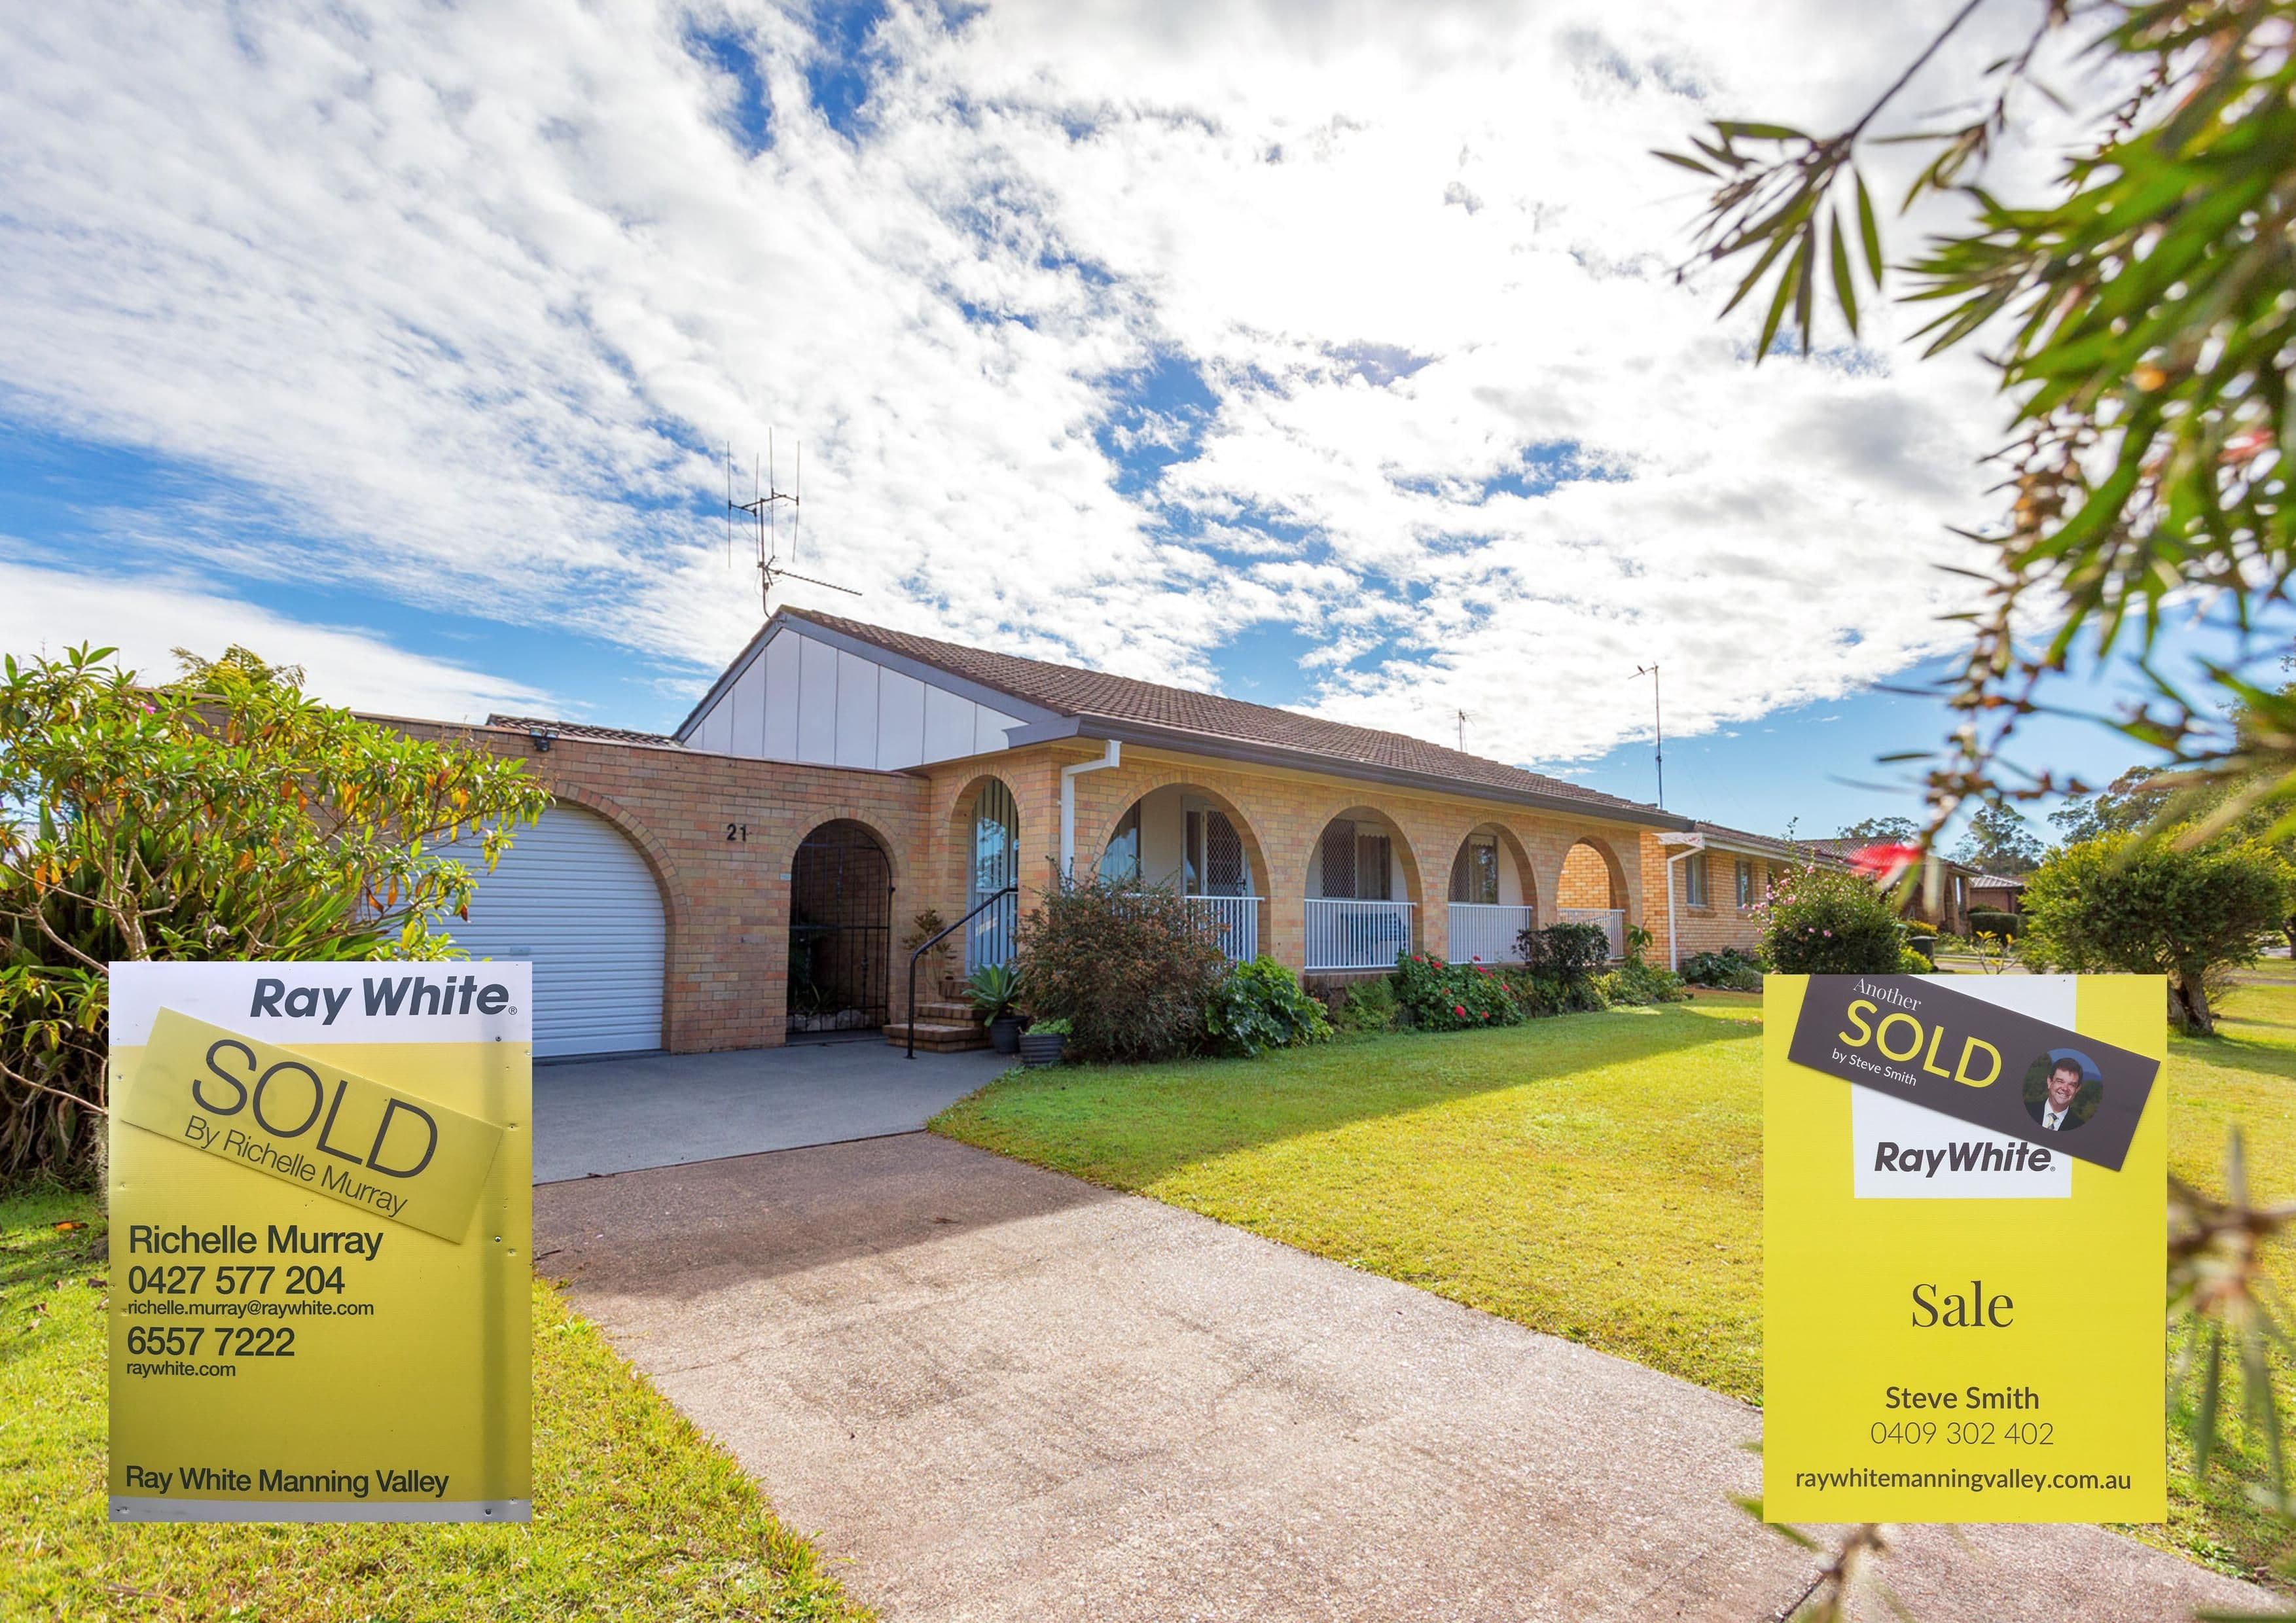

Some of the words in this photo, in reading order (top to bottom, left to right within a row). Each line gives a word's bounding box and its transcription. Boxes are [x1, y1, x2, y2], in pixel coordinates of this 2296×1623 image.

[726, 823, 747, 842] 21
[250, 978, 351, 1025] Ray
[362, 976, 509, 1017] White
[1854, 978, 1921, 1011] Another
[1839, 999, 2001, 1088] SOLD
[1832, 1048, 1847, 1063] by
[1849, 1054, 1881, 1075] Steve
[1884, 1066, 1916, 1086] Smith
[192, 1039, 437, 1178] SOLD
[185, 1115, 221, 1149] By
[223, 1128, 315, 1181] Richelle
[321, 1164, 408, 1217] Murray
[130, 1224, 257, 1253] Richelle
[268, 1224, 384, 1260] Murray
[128, 1266, 206, 1294] 0427
[215, 1266, 276, 1294] 577
[285, 1266, 345, 1294] 204
[128, 1299, 374, 1319] richelle.murray@raywhite.com
[1912, 1280, 2014, 1327] Sale
[127, 1326, 205, 1355] 6557
[215, 1327, 295, 1356] 7222
[126, 1361, 236, 1378] raywhite.com
[1886, 1386, 1958, 1409] Steve
[1965, 1386, 2039, 1409] Smith
[1871, 1421, 1937, 1444] 0409
[1946, 1421, 1996, 1445] 302
[2004, 1422, 2054, 1445] 402
[126, 1465, 173, 1494] Ray
[179, 1467, 251, 1492] White
[259, 1469, 369, 1497] Manning
[376, 1469, 449, 1497] Valley
[1795, 1468, 2131, 1492] raywhitemanningvalley.com.au
